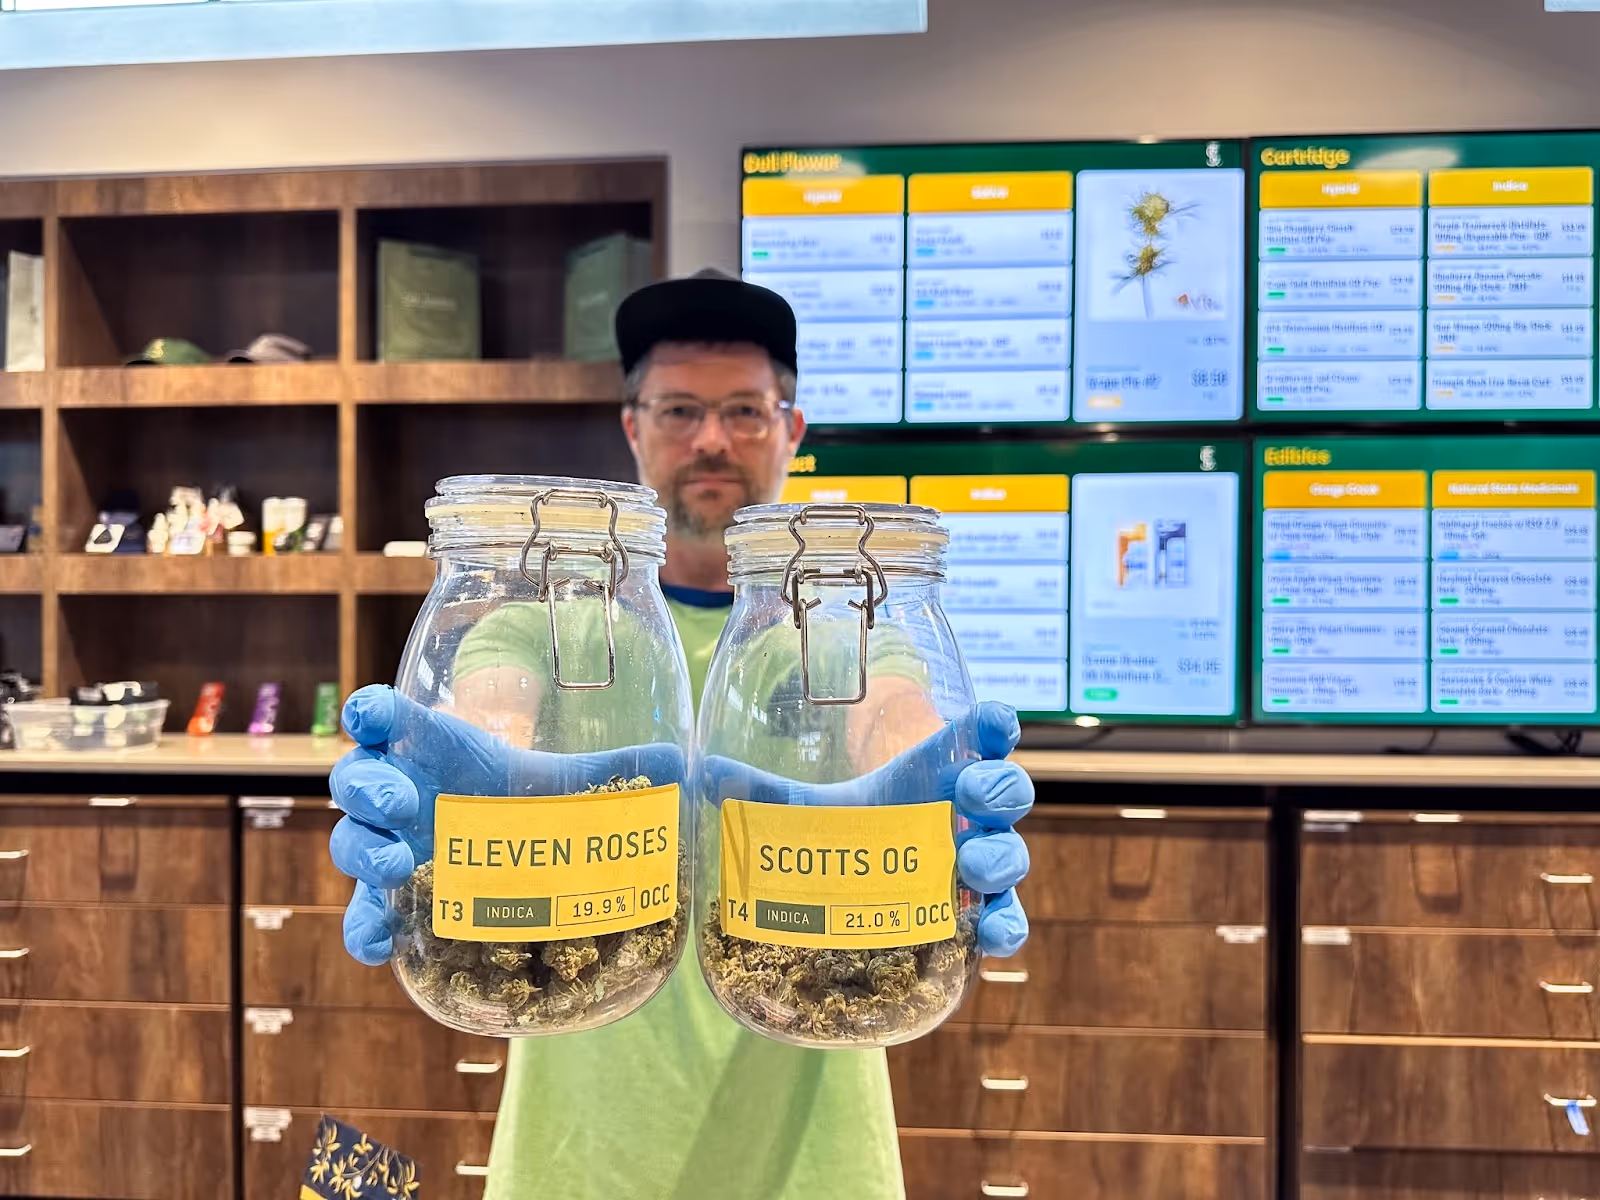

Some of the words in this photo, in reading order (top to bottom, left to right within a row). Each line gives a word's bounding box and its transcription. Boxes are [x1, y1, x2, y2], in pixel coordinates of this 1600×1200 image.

[1261, 146, 1350, 169] Cartridge
[1264, 446, 1331, 466] Edibles
[448, 837, 571, 867] ELEVEN
[586, 825, 667, 864] ROSES
[759, 844, 870, 876] SCOTTS
[883, 846, 918, 875] OG
[439, 899, 463, 922] T3
[486, 906, 535, 920] INDICA
[640, 883, 670, 910] OCC
[728, 899, 749, 922] T4
[766, 909, 810, 925] INDICA
[915, 902, 950, 927] OCC
